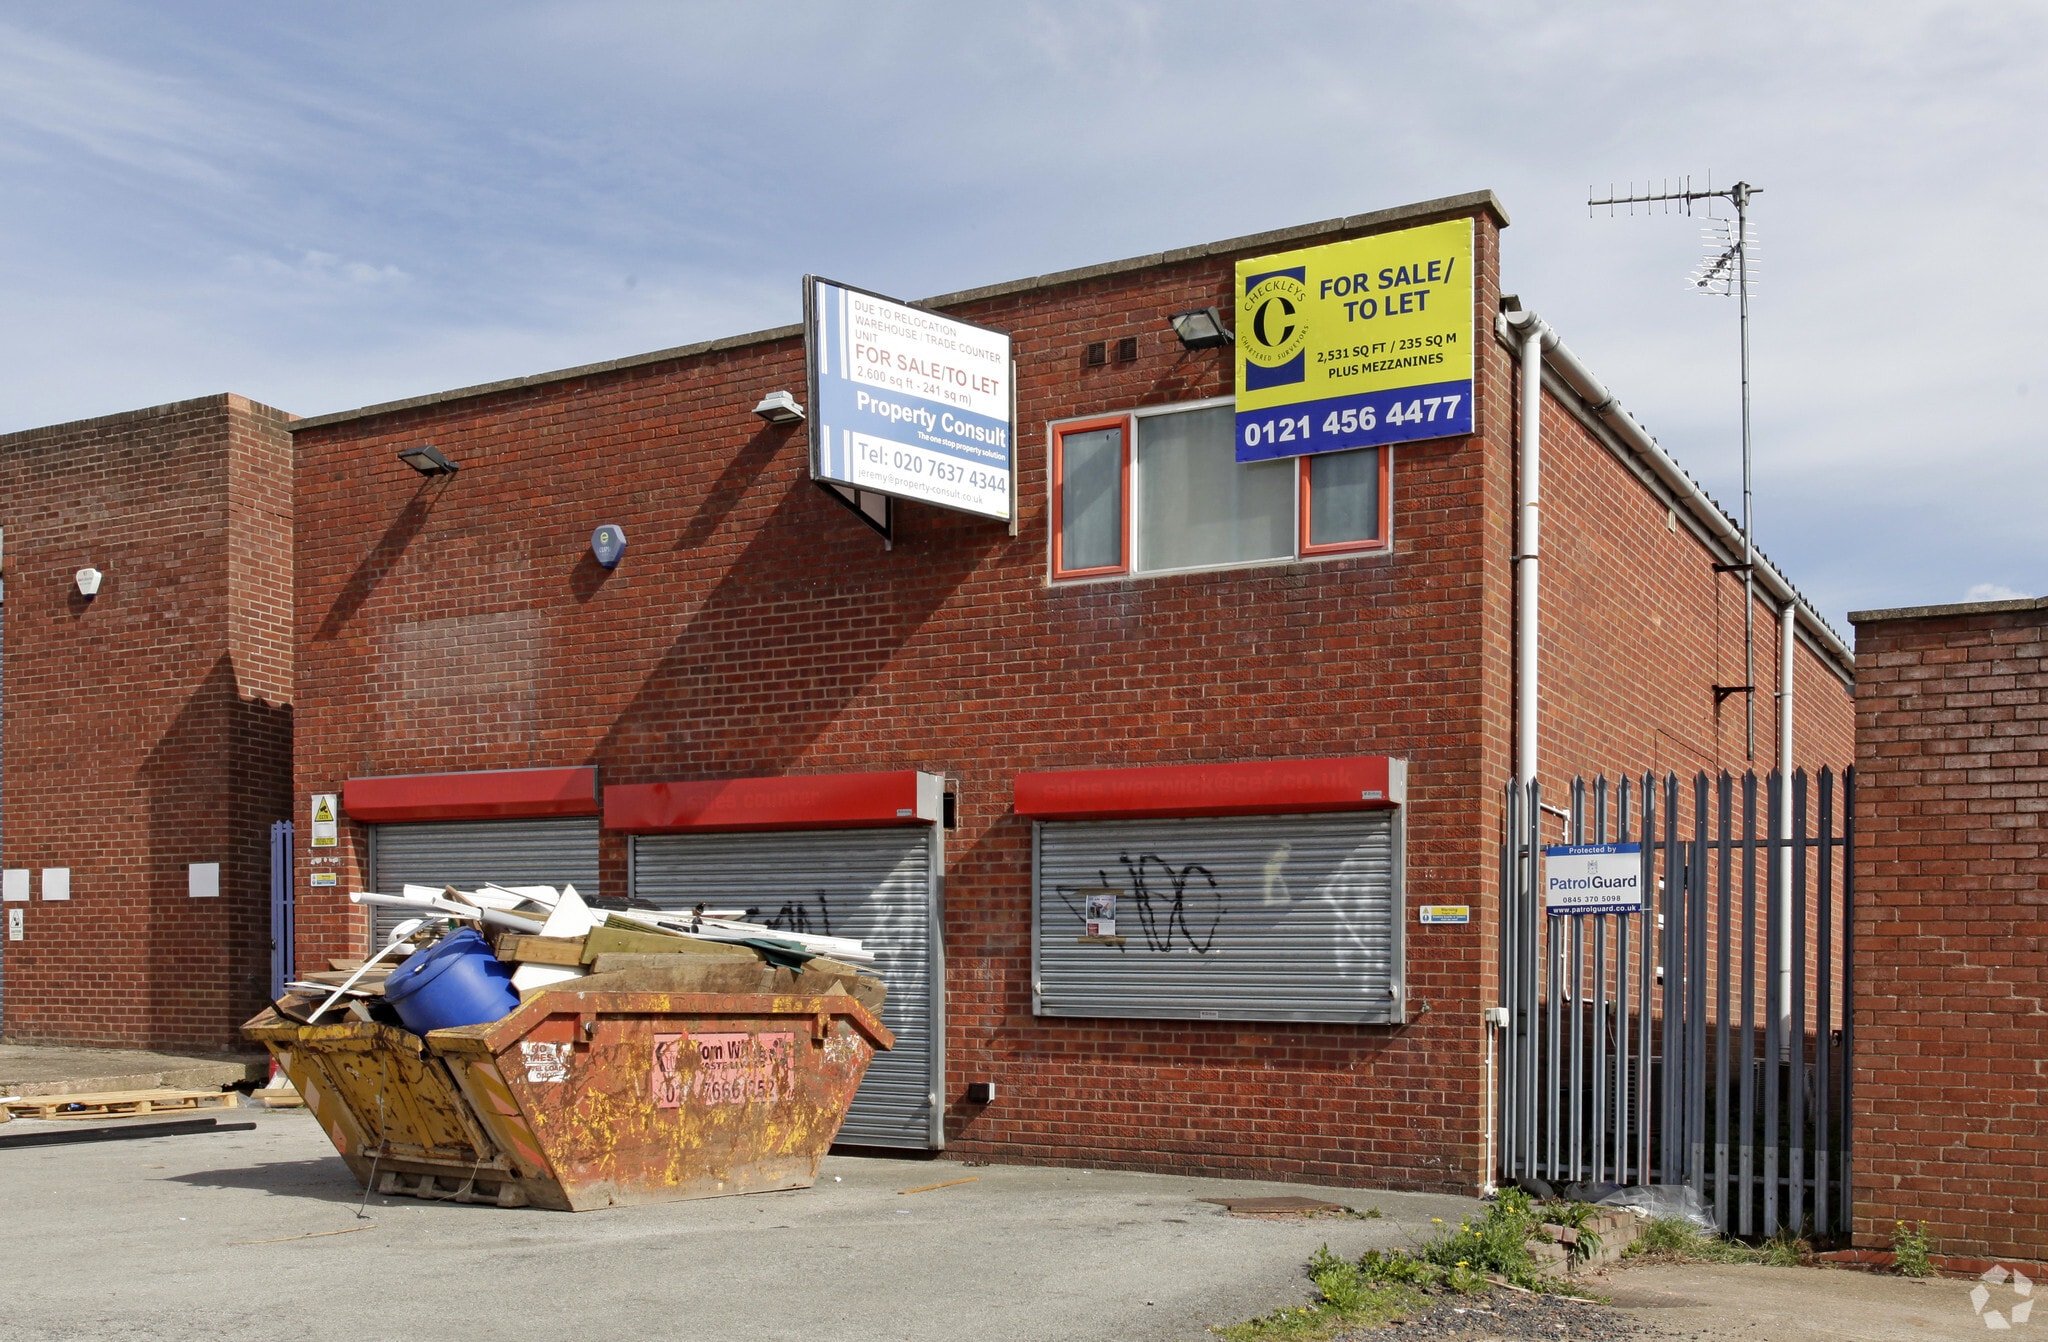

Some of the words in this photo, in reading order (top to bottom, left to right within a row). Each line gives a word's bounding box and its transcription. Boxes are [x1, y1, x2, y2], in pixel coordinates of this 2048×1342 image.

[1320, 273, 1370, 299] FOR
[1378, 257, 1455, 290] SALE/
[1244, 280, 1306, 311] CHECKLEYS
[1343, 298, 1377, 322] TO
[1385, 289, 1430, 316] LET
[855, 300, 875, 315] DUE
[878, 306, 892, 319] TO
[894, 311, 957, 337] RELOCATION
[1253, 296, 1296, 347] C
[855, 329, 878, 343] UNIT
[855, 315, 918, 340] WAREHOUSE
[925, 333, 957, 350] TRADE
[959, 343, 1001, 364] COUNTER
[1241, 335, 1272, 361] CHARTERED
[1277, 325, 1309, 360] SURVEYORS
[1317, 345, 1349, 364] 2,531
[1352, 344, 1369, 358] SQ
[1372, 341, 1386, 354] FT
[1399, 337, 1422, 351] 235
[1425, 334, 1443, 348] SQ
[1446, 332, 1457, 344] M
[856, 343, 892, 368] FOR
[897, 354, 967, 387] SALE/TO
[972, 374, 999, 396] LET
[1328, 364, 1359, 379] PLUS
[1362, 352, 1444, 374] MEZZANINES
[890, 375, 903, 389] sq
[906, 377, 913, 389] ft
[923, 382, 940, 396] 241
[944, 390, 956, 404] sq
[959, 393, 972, 407] m)
[856, 390, 937, 433] Property
[941, 412, 1006, 448] Consult
[1244, 415, 1311, 447] 0121
[1322, 406, 1376, 435] 456
[1385, 395, 1462, 426] 4477
[917, 431, 929, 441] The
[929, 436, 942, 444] one
[942, 438, 956, 450] stop
[956, 441, 982, 456] property
[982, 448, 1006, 461] solution
[858, 442, 888, 465] Tel:
[894, 451, 922, 474] 020
[928, 459, 964, 484] 7637
[969, 470, 1006, 494] 4344
[858, 469, 983, 504] jeremy@property-consult.co.uk
[1569, 846, 1605, 855] Protected
[1607, 846, 1617, 854] by
[1549, 875, 1637, 890] PatrolGuard
[1584, 895, 1599, 903] 370
[1553, 905, 1636, 914] www.patrolguard.co.uk
